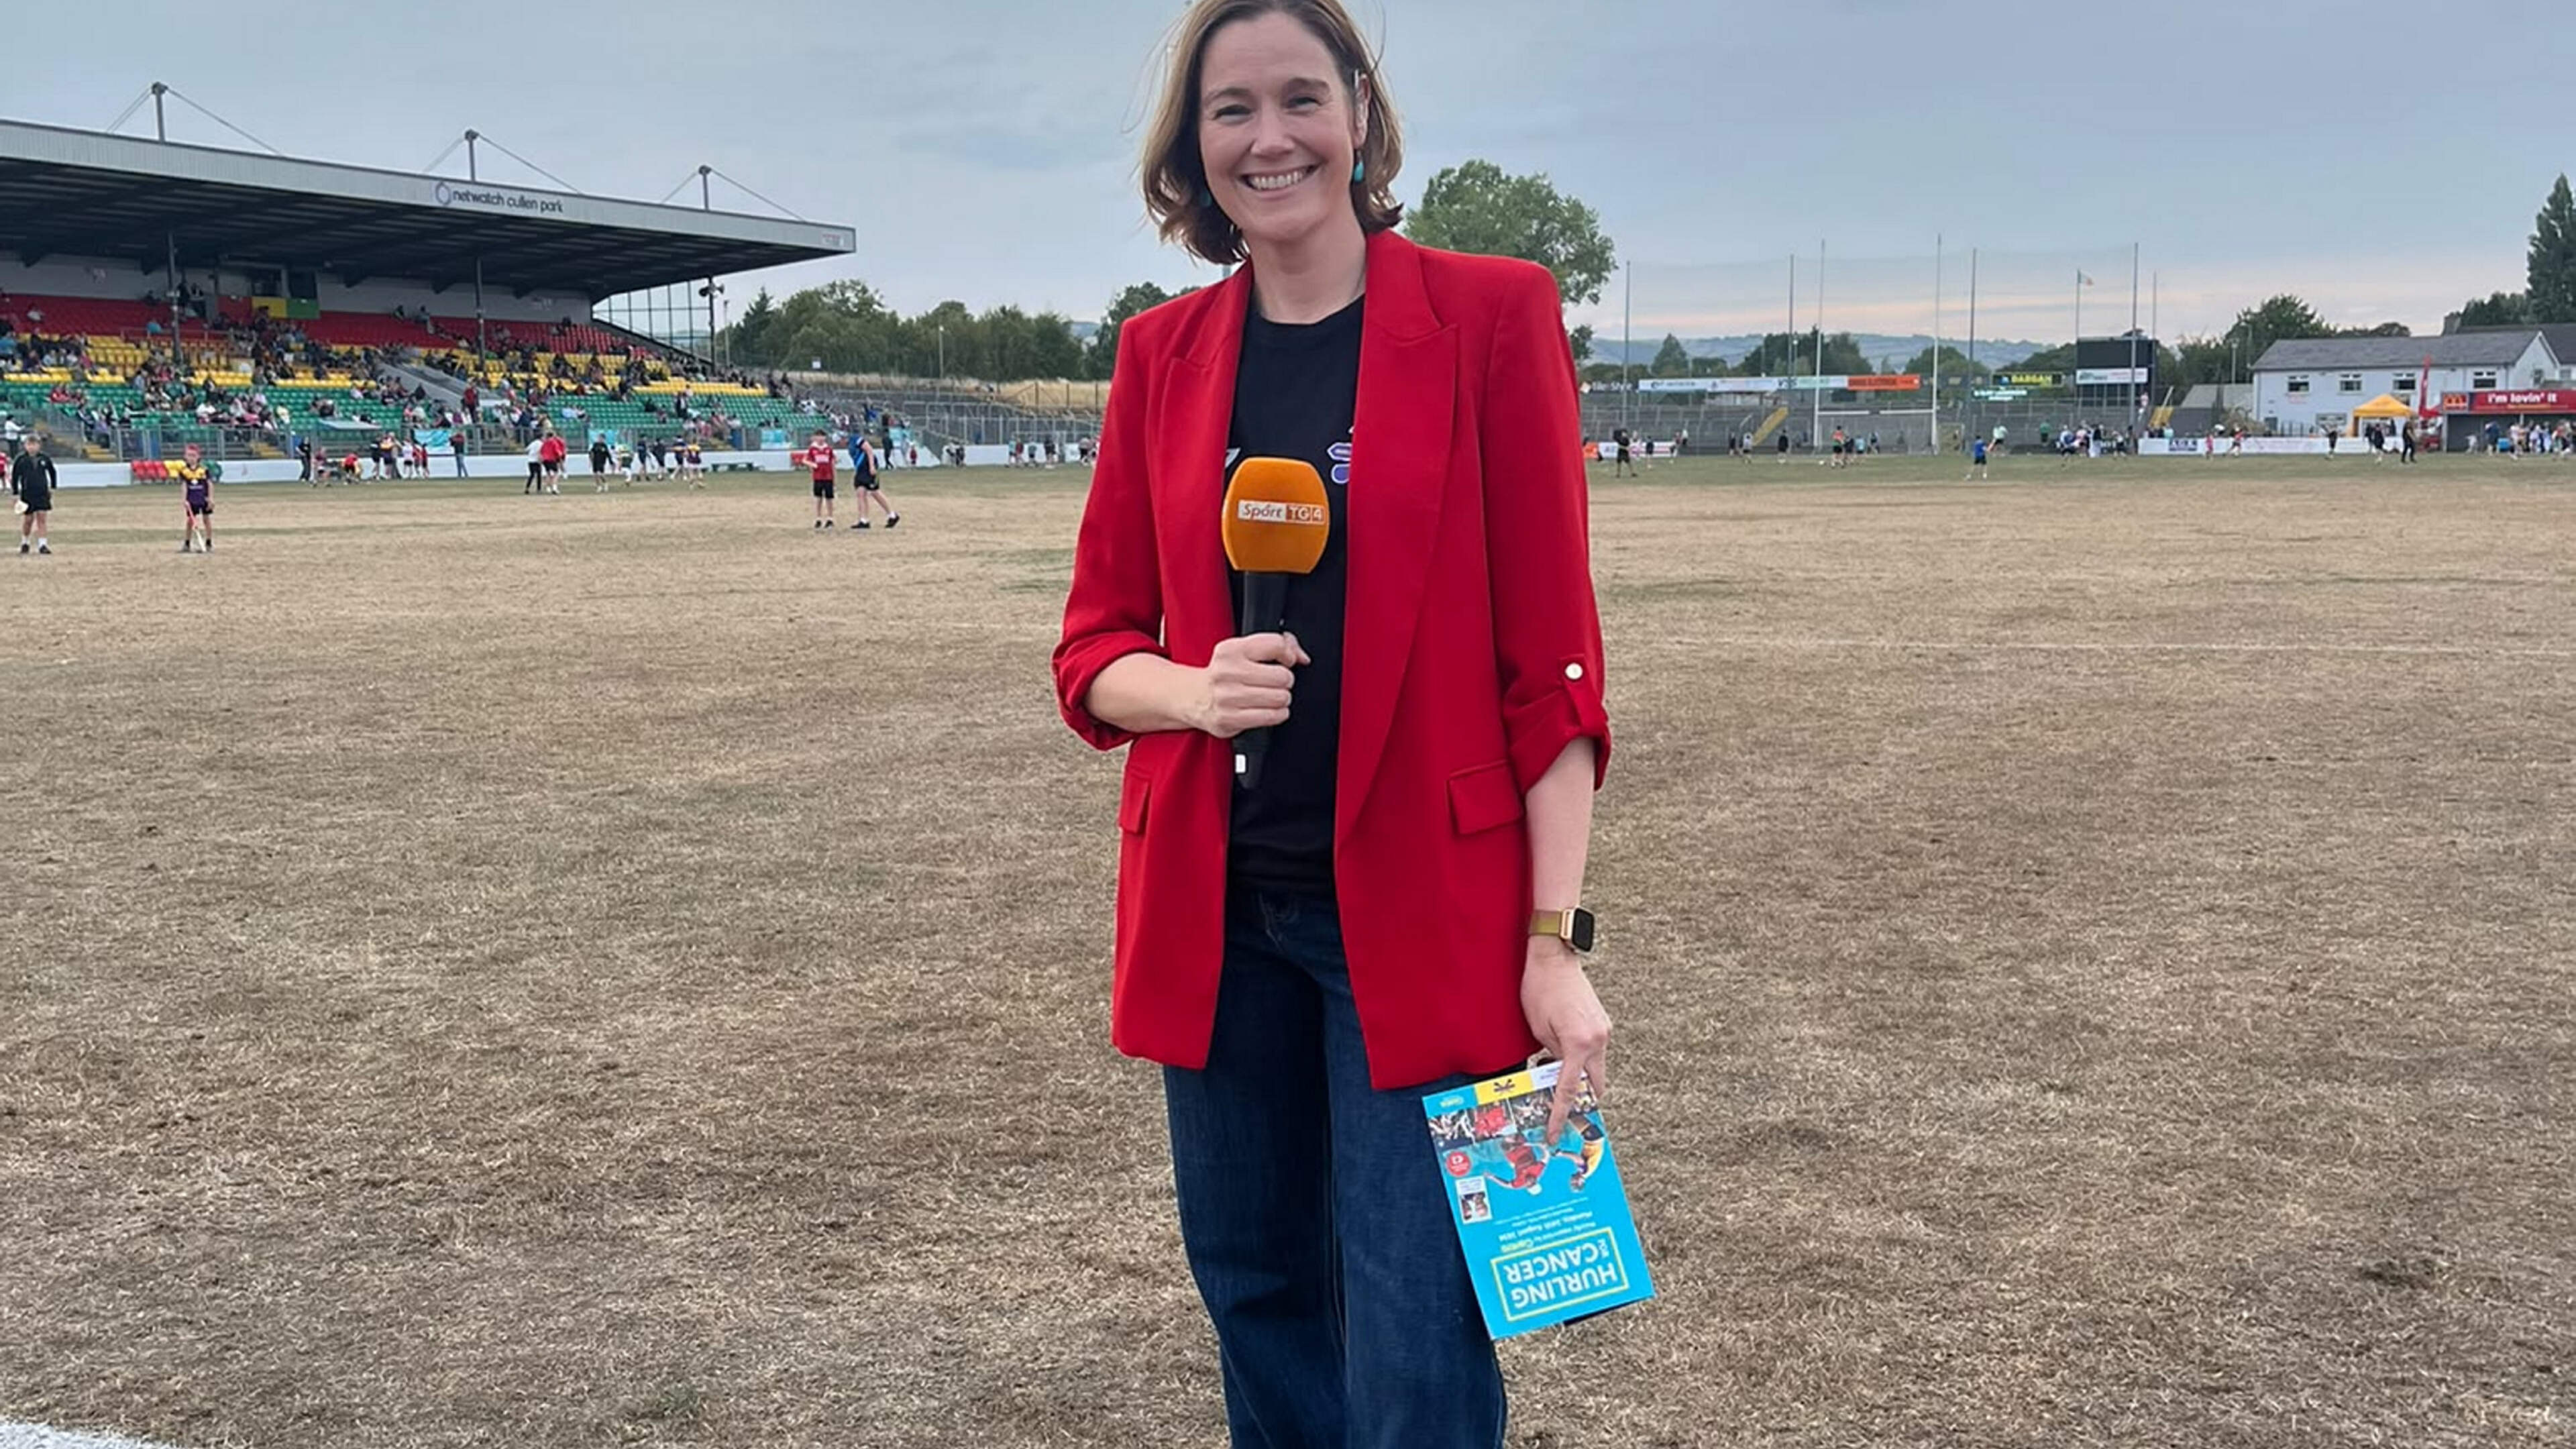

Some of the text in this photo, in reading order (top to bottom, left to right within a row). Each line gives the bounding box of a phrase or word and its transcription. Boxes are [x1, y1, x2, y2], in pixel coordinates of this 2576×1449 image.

[453, 189, 563, 213] netwatch cullen park
[2510, 392, 2544, 402] lovin'
[2547, 392, 2557, 402] it
[1503, 1242, 1599, 1284] CANCER
[1511, 1263, 1618, 1309] HURLING
